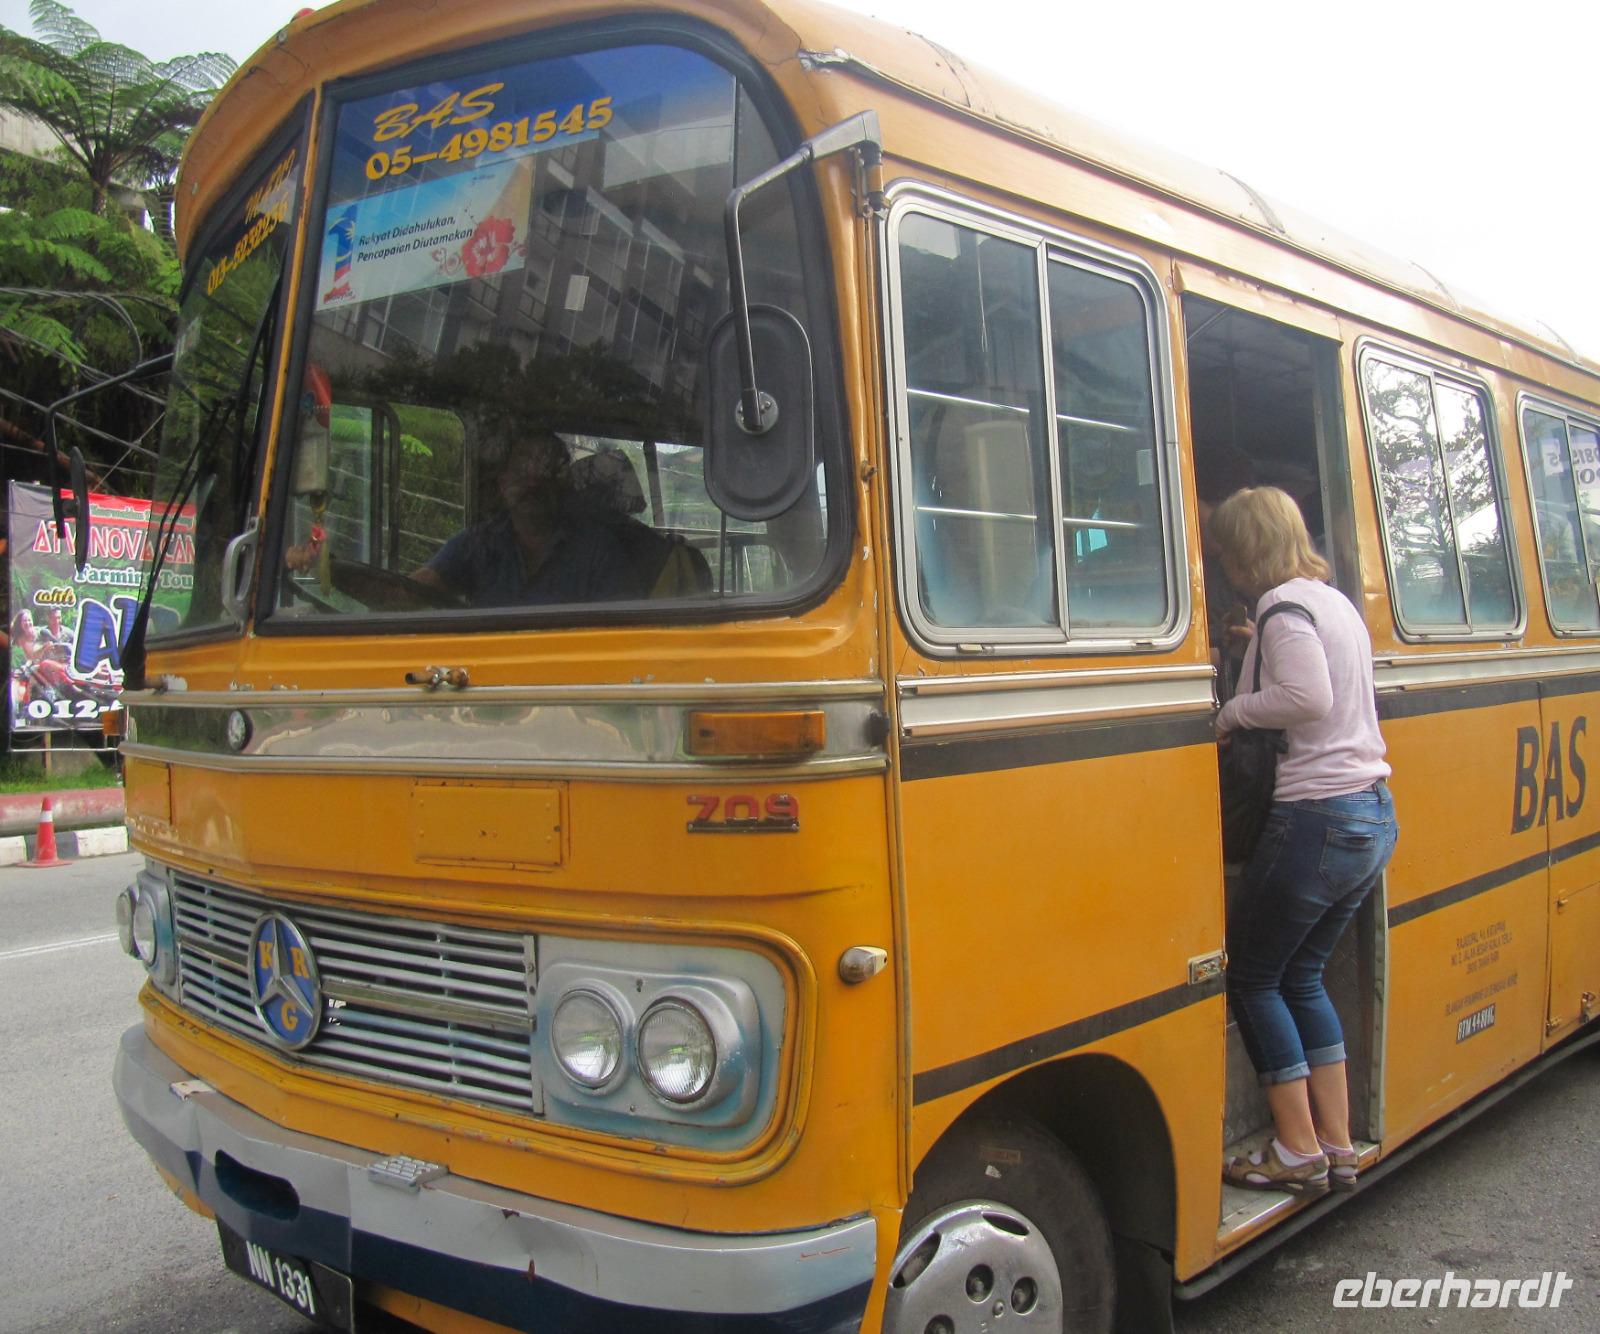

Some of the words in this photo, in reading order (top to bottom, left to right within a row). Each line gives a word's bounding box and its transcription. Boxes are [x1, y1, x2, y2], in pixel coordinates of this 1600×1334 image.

[373, 82, 505, 142] BAS
[365, 96, 613, 180] 05-4981545
[357, 242, 412, 263] Pencapaian
[412, 228, 473, 251] Diutamakan
[358, 230, 391, 247] Rakyat
[90, 526, 155, 561] NOVA
[35, 588, 76, 606] with
[1511, 715, 1587, 835] BAS
[687, 793, 800, 824] 709
[281, 1003, 298, 1031] G
[246, 1240, 275, 1287] NN
[275, 1257, 316, 1315] 1331
